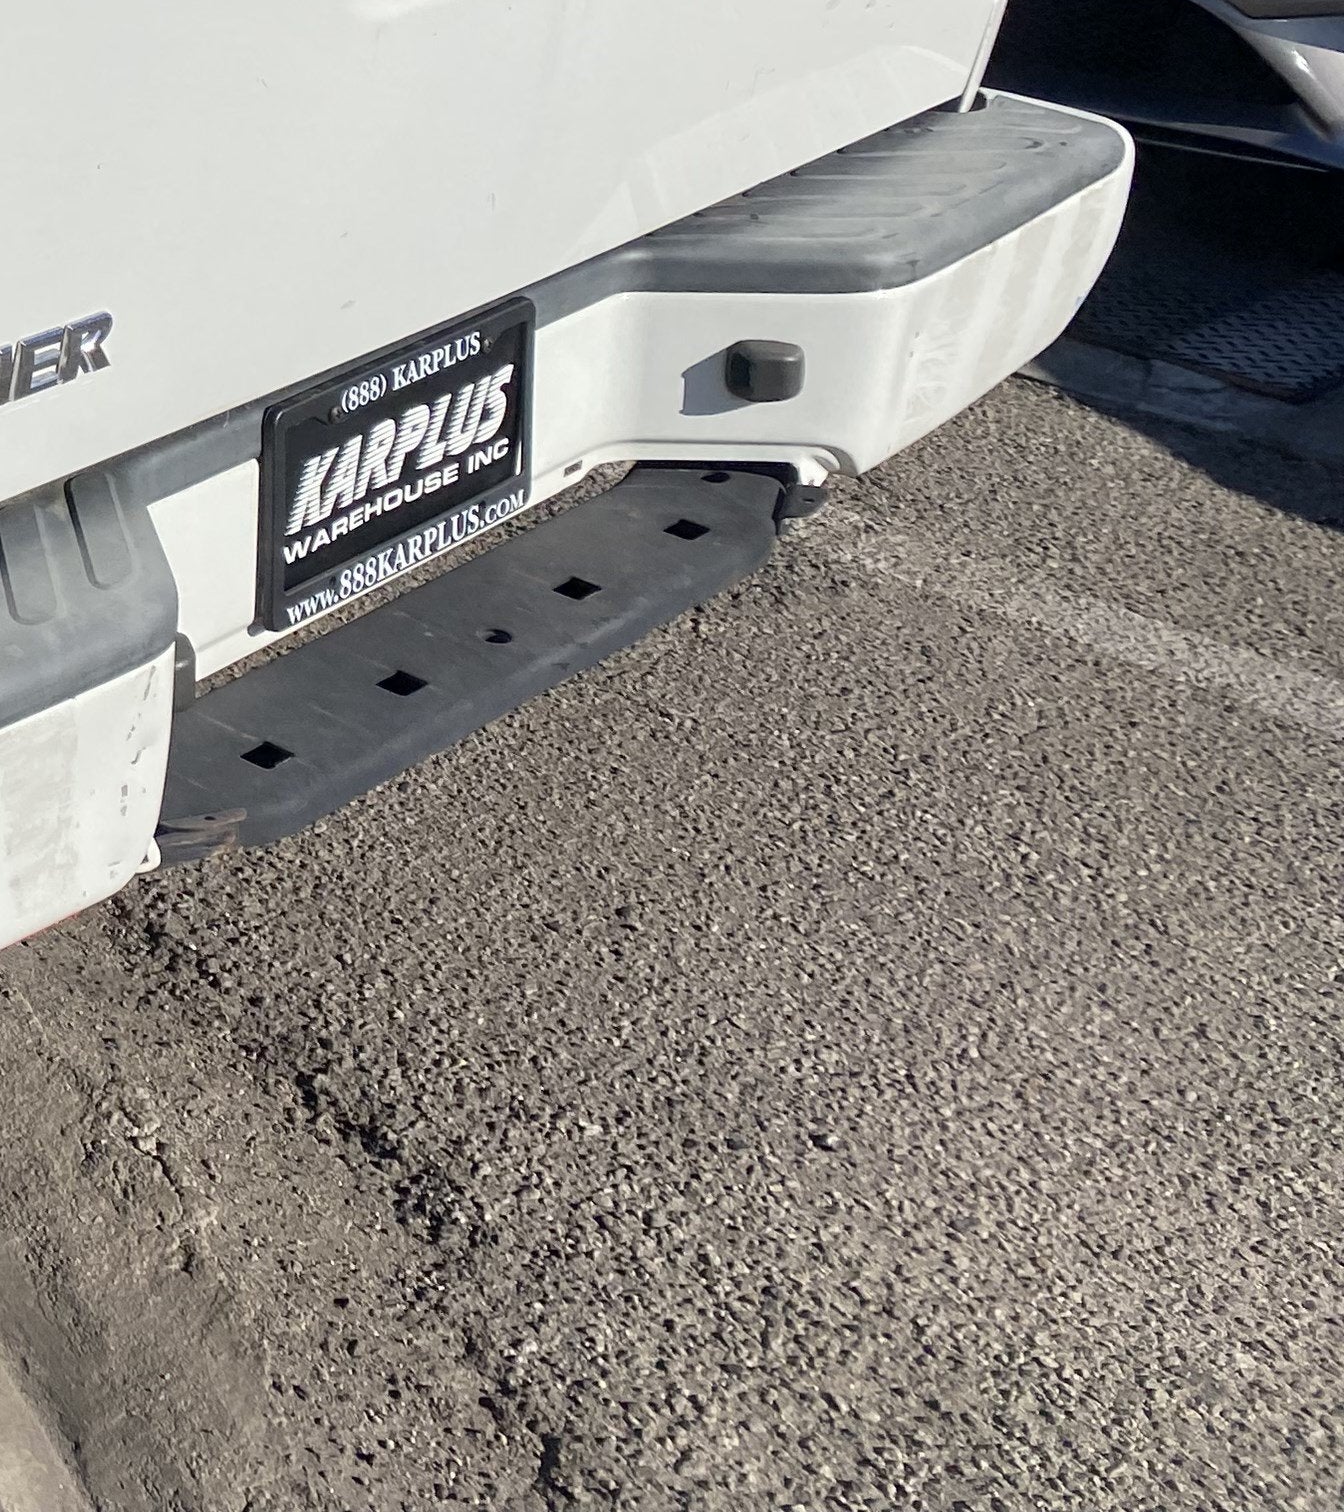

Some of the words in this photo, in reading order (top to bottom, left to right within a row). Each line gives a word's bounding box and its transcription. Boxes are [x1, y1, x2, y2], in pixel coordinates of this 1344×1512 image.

[341, 373, 387, 414] (888)
[392, 331, 481, 391] KARPLUS
[283, 463, 459, 565] WAREHOUSE
[467, 438, 509, 474] INC
[284, 363, 514, 537] KARPLUS
